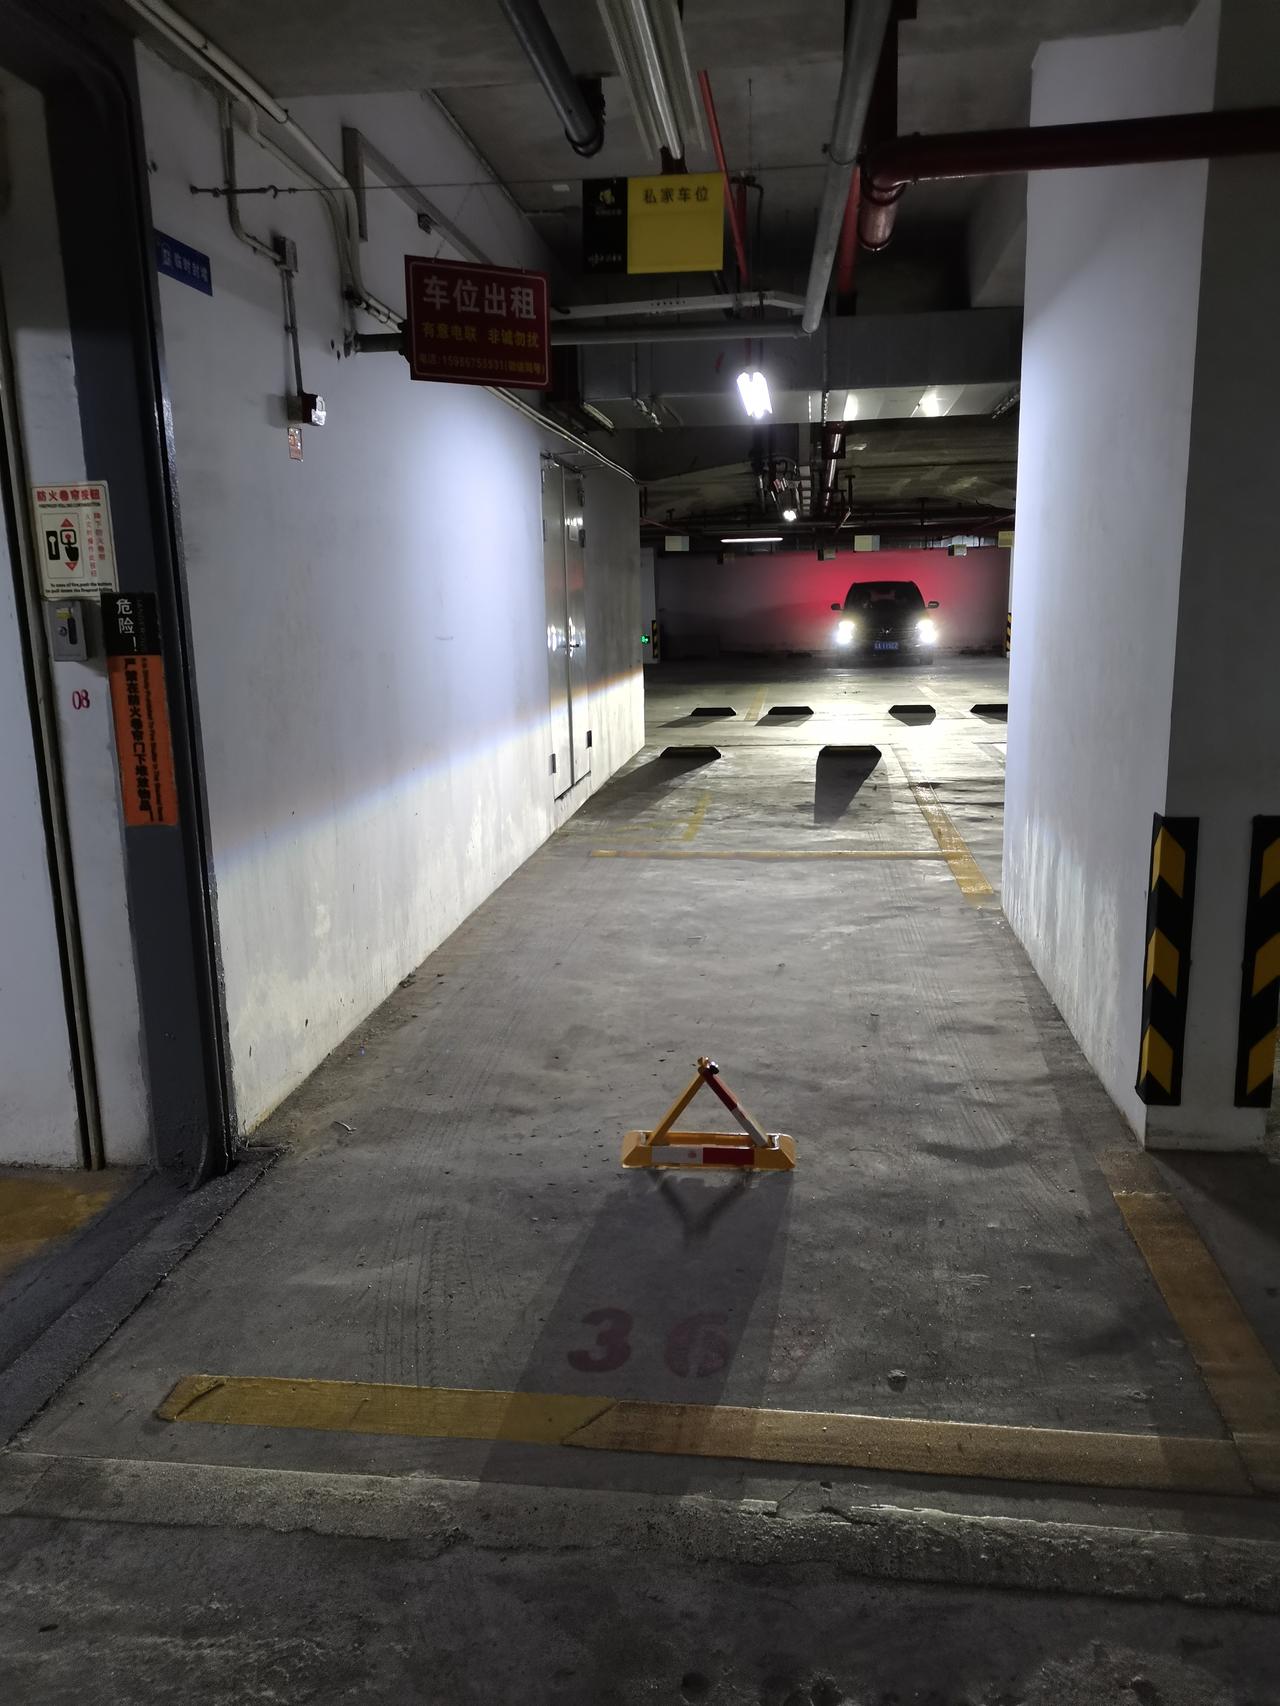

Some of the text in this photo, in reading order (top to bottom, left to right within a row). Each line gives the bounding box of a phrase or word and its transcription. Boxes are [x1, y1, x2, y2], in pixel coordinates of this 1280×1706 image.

[643, 185, 708, 204] 私家车位
[423, 275, 537, 320] 车位出租
[487, 328, 540, 348] 非诚勿扰
[36, 489, 101, 502] 防火卷帘按钮
[72, 689, 90, 710] 08
